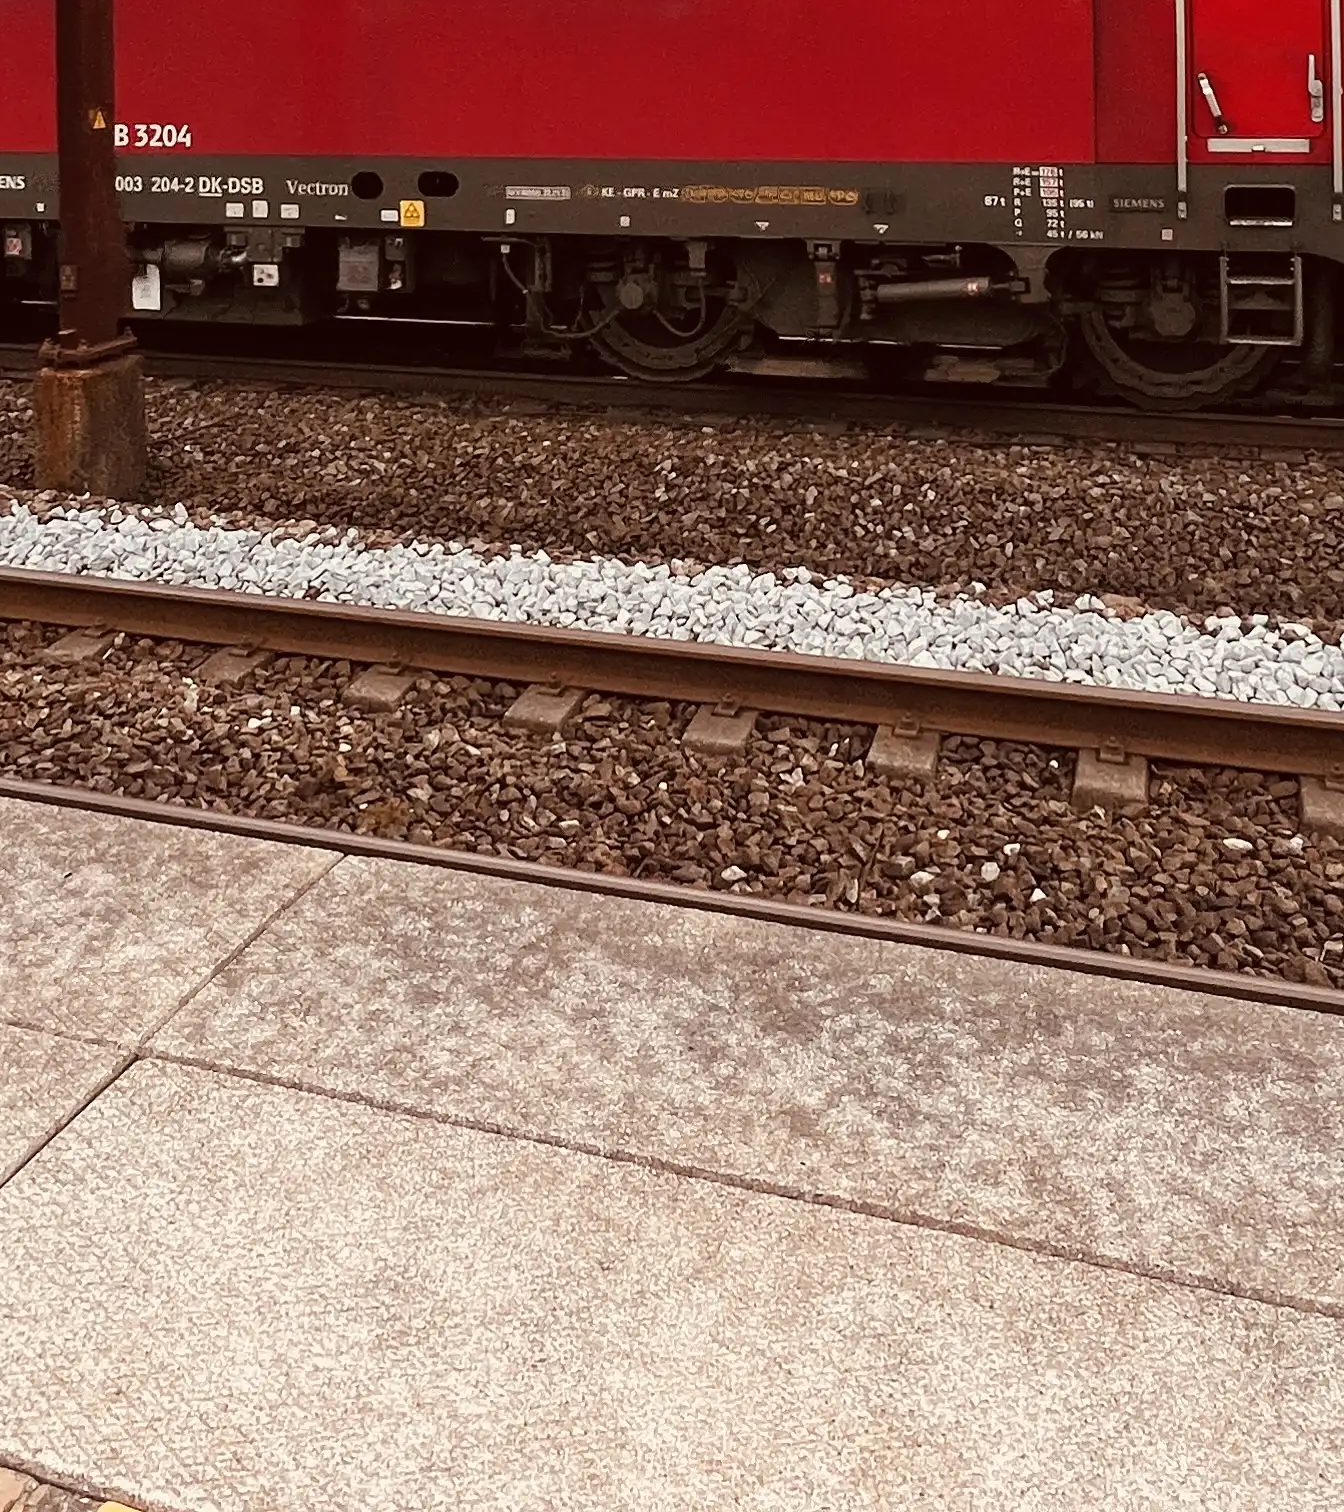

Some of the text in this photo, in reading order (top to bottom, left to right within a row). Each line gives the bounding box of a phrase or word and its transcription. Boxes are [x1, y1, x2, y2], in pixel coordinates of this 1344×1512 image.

[134, 123, 192, 148] 3204
[114, 175, 265, 196] 003 204-2 DK-DSB
[285, 179, 349, 197] Vectron
[1113, 198, 1165, 208] SIEMENS
[1046, 219, 1059, 228] 72
